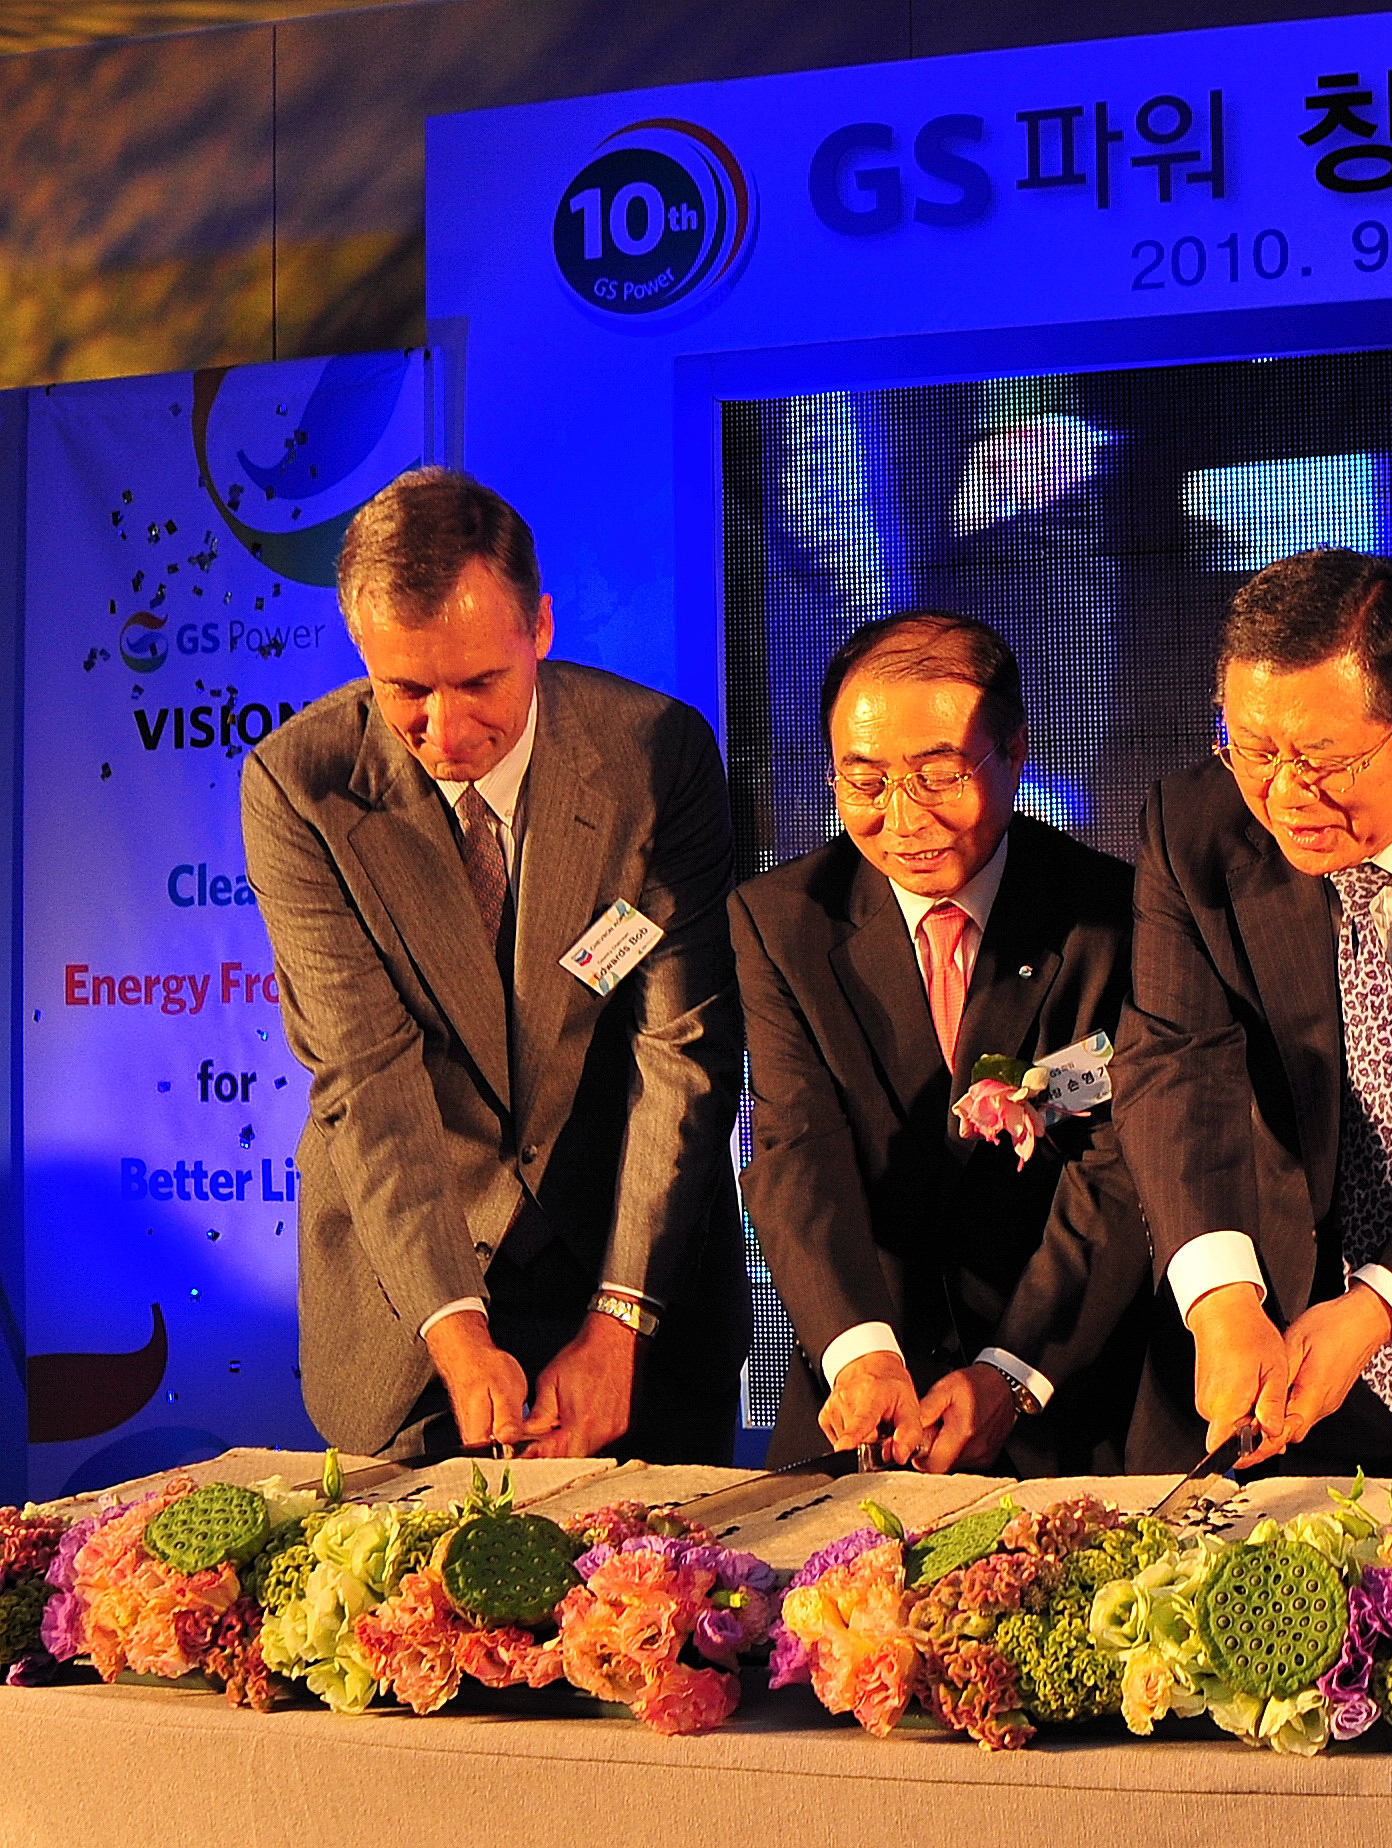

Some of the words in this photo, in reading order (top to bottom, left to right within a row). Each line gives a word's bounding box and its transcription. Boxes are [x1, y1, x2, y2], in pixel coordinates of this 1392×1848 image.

[568, 181, 699, 262] 10th
[1131, 227, 1314, 292] 2010.
[593, 276, 620, 301] GS
[623, 265, 677, 300] Power
[176, 622, 220, 655] GS
[229, 620, 326, 652] Power
[628, 926, 649, 946] Bob
[65, 963, 211, 1015] Energy
[198, 1059, 257, 1102] for
[120, 1158, 253, 1202] Better
[261, 1158, 301, 1202] Li
